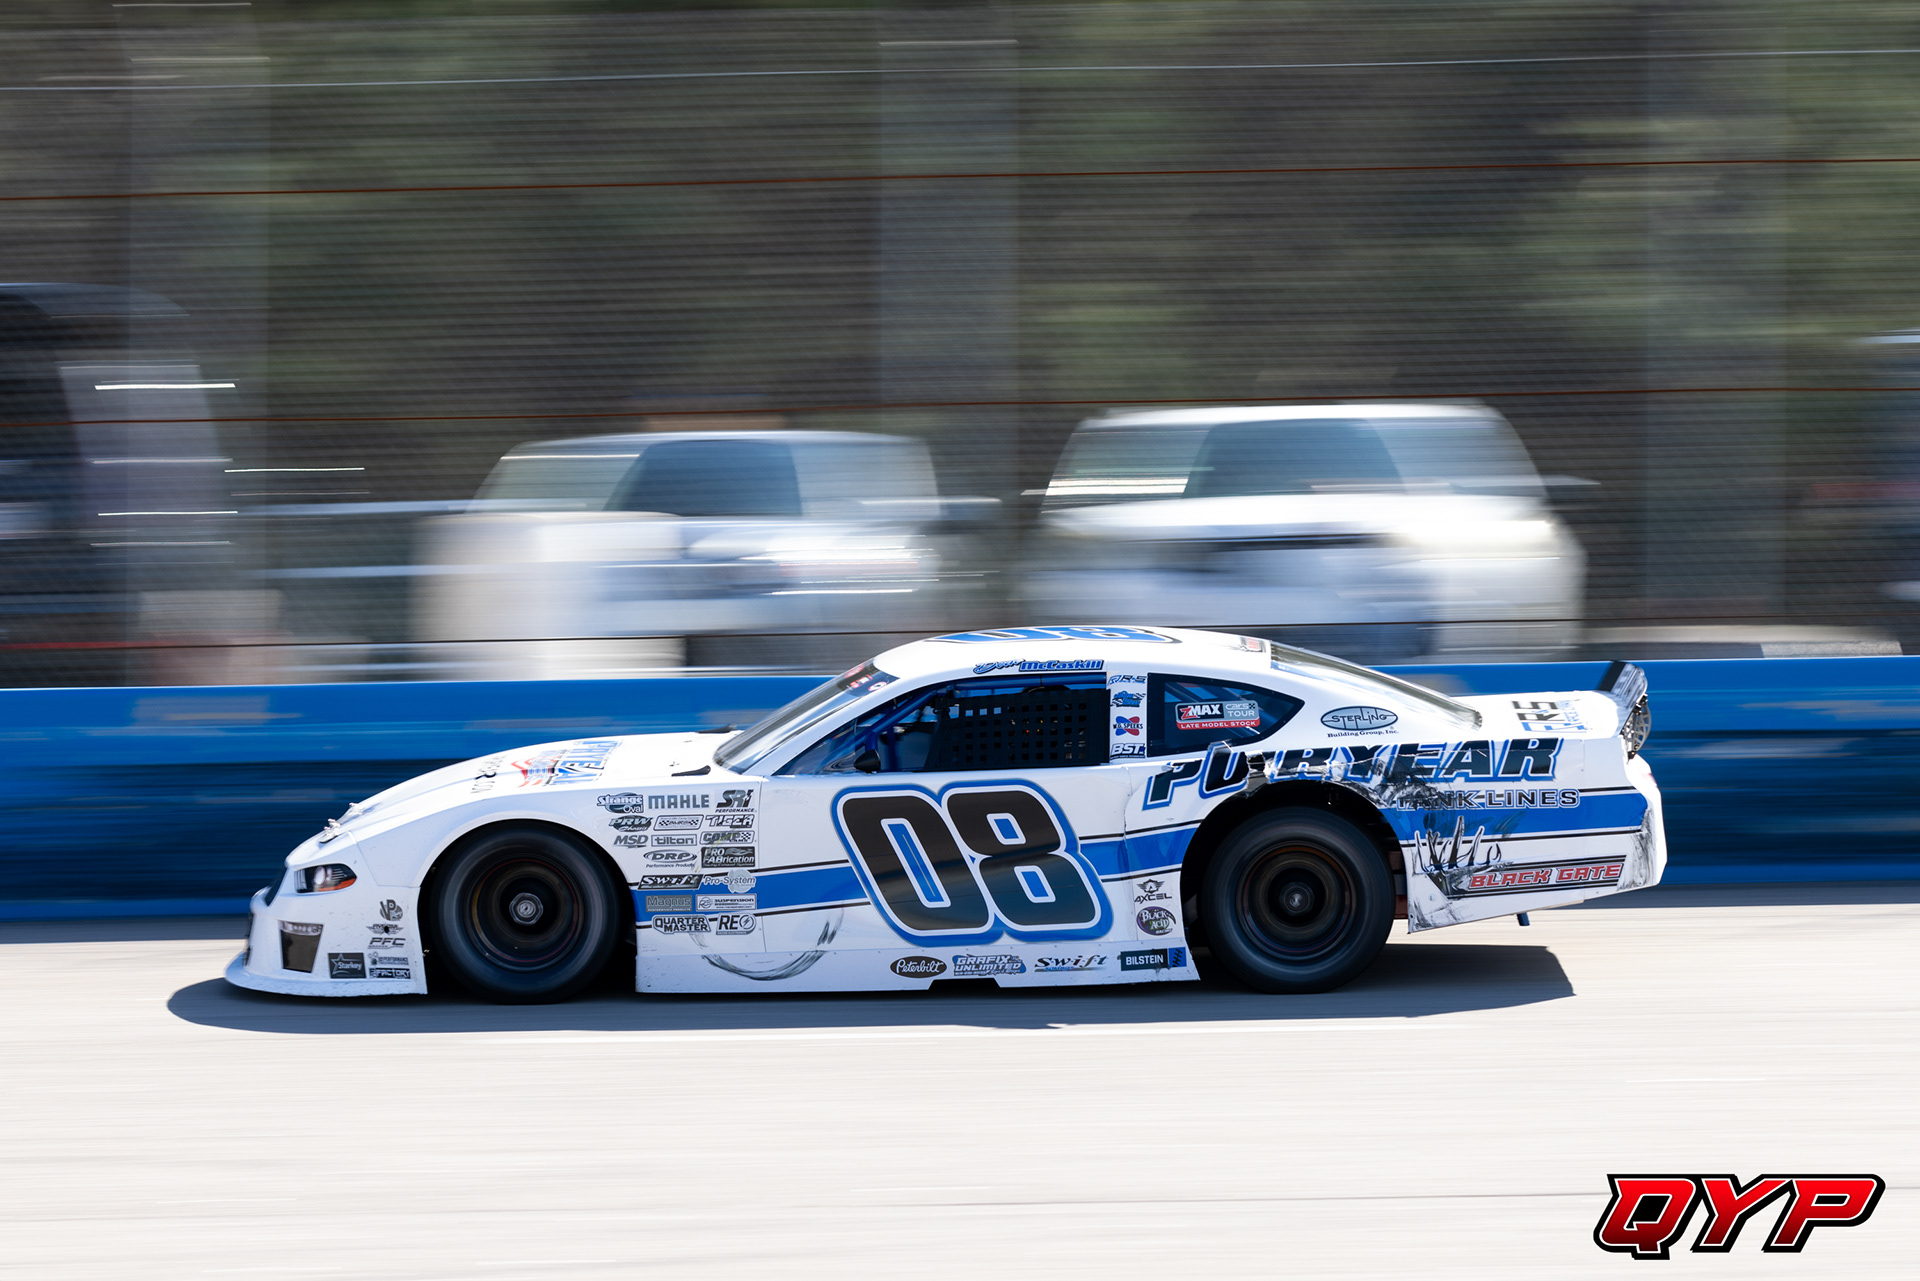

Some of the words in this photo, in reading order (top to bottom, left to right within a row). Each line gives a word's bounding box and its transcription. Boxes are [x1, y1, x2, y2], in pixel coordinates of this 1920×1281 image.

[925, 625, 1182, 644] 08
[1019, 659, 1104, 672] McCaskill
[1142, 737, 1563, 811] PURYEAR
[597, 794, 644, 806] Strange
[648, 794, 709, 809] MAHLE
[716, 789, 754, 808] SRI
[1485, 788, 1581, 809] LINES
[623, 805, 644, 813] Oval
[608, 817, 654, 827] PRW
[705, 814, 755, 827] TIGER
[613, 834, 649, 845] MSD
[655, 836, 694, 845] tilton
[651, 852, 690, 861] DRP
[704, 848, 725, 856] PRO
[831, 778, 1113, 948] 08
[640, 874, 700, 885] Swift
[705, 876, 755, 885] Pro-System
[1468, 867, 1553, 890] BLACK
[1555, 862, 1624, 883] GATE
[647, 895, 691, 907] Magnus
[1134, 893, 1173, 904] AXCEL
[380, 899, 397, 921] VP
[655, 916, 706, 928] QUARTER
[663, 923, 708, 932] MASTER
[369, 937, 406, 946] PFC
[955, 955, 1011, 965] GRAFIX
[1034, 954, 1110, 968] Swift
[1125, 954, 1164, 965] BILSTEIN
[337, 961, 362, 971] Starkey
[896, 958, 944, 974] Peterbilt
[954, 962, 1022, 972] UNLIMITED
